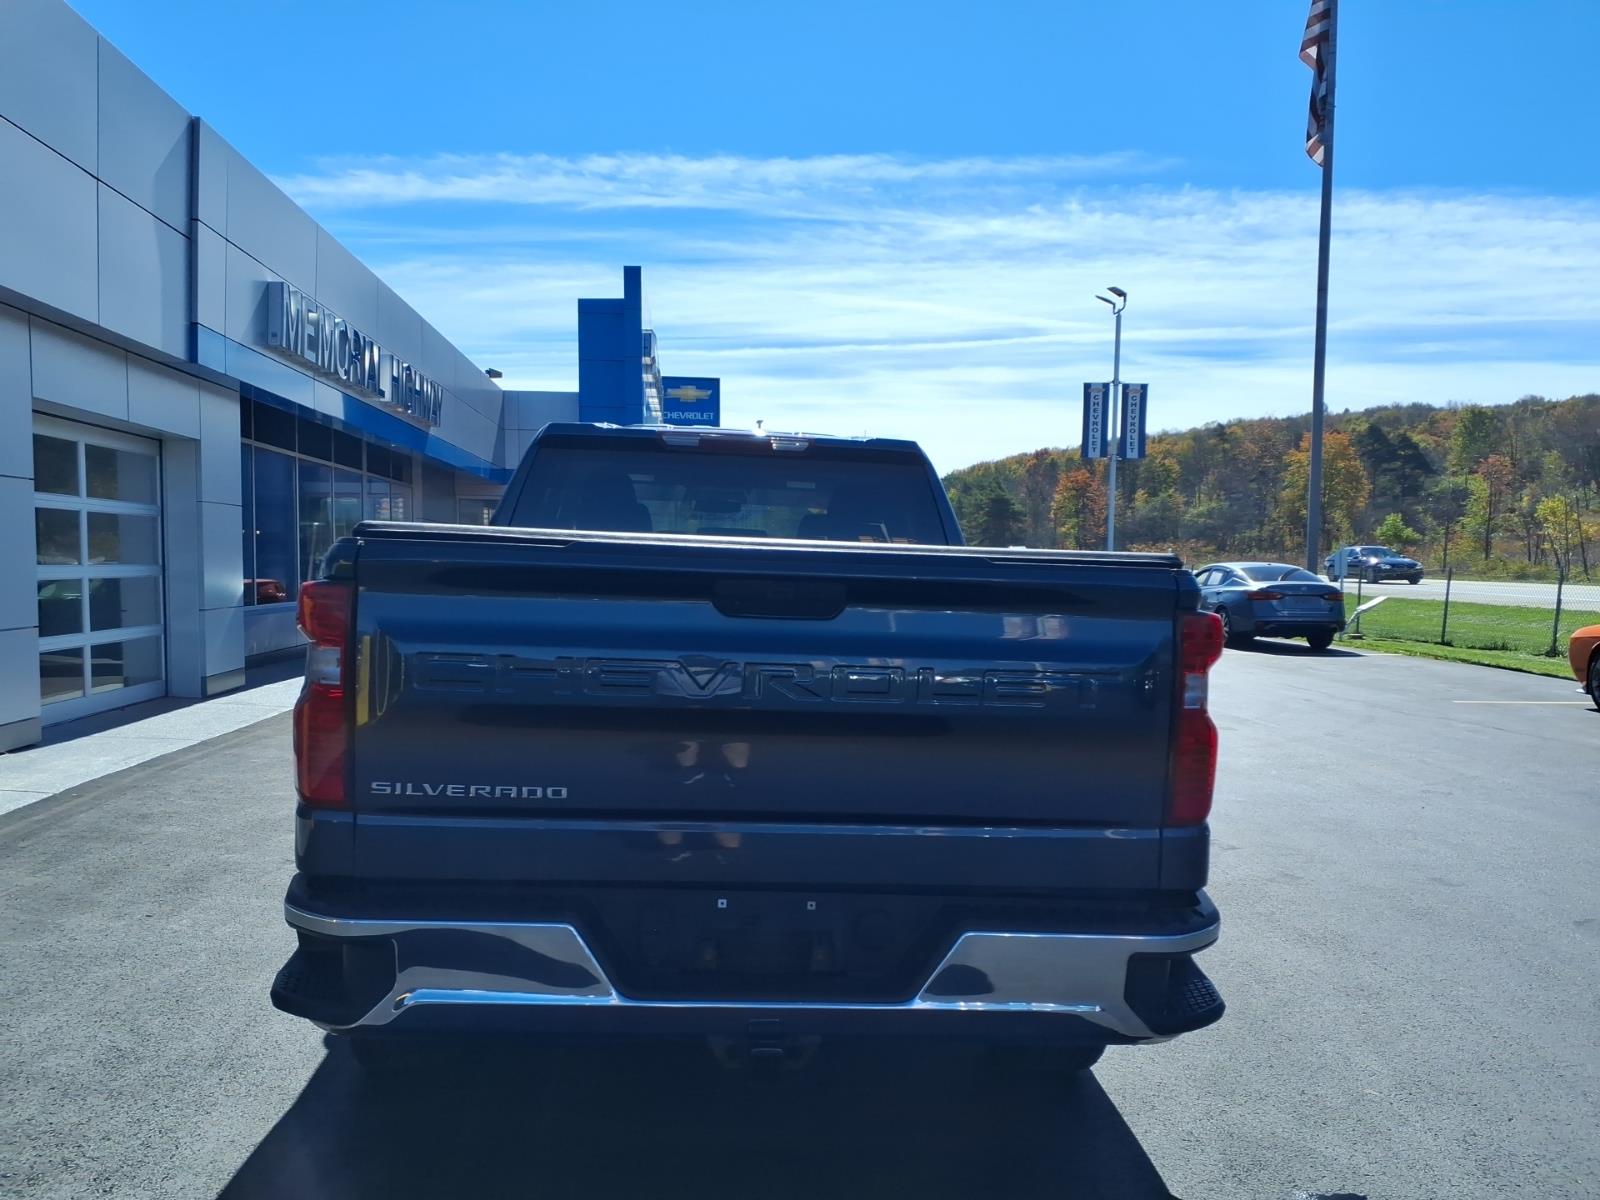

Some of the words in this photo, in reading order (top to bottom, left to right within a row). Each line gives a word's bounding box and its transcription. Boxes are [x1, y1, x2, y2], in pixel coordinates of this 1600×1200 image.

[279, 281, 386, 398] MEMORIAL
[391, 354, 443, 428] HIGHWAY
[1091, 394, 1100, 453] CHEVROLET
[1129, 395, 1137, 454] CHEVROLET
[411, 651, 1123, 709] CHEVROLET
[371, 781, 568, 799] SILVERADO
